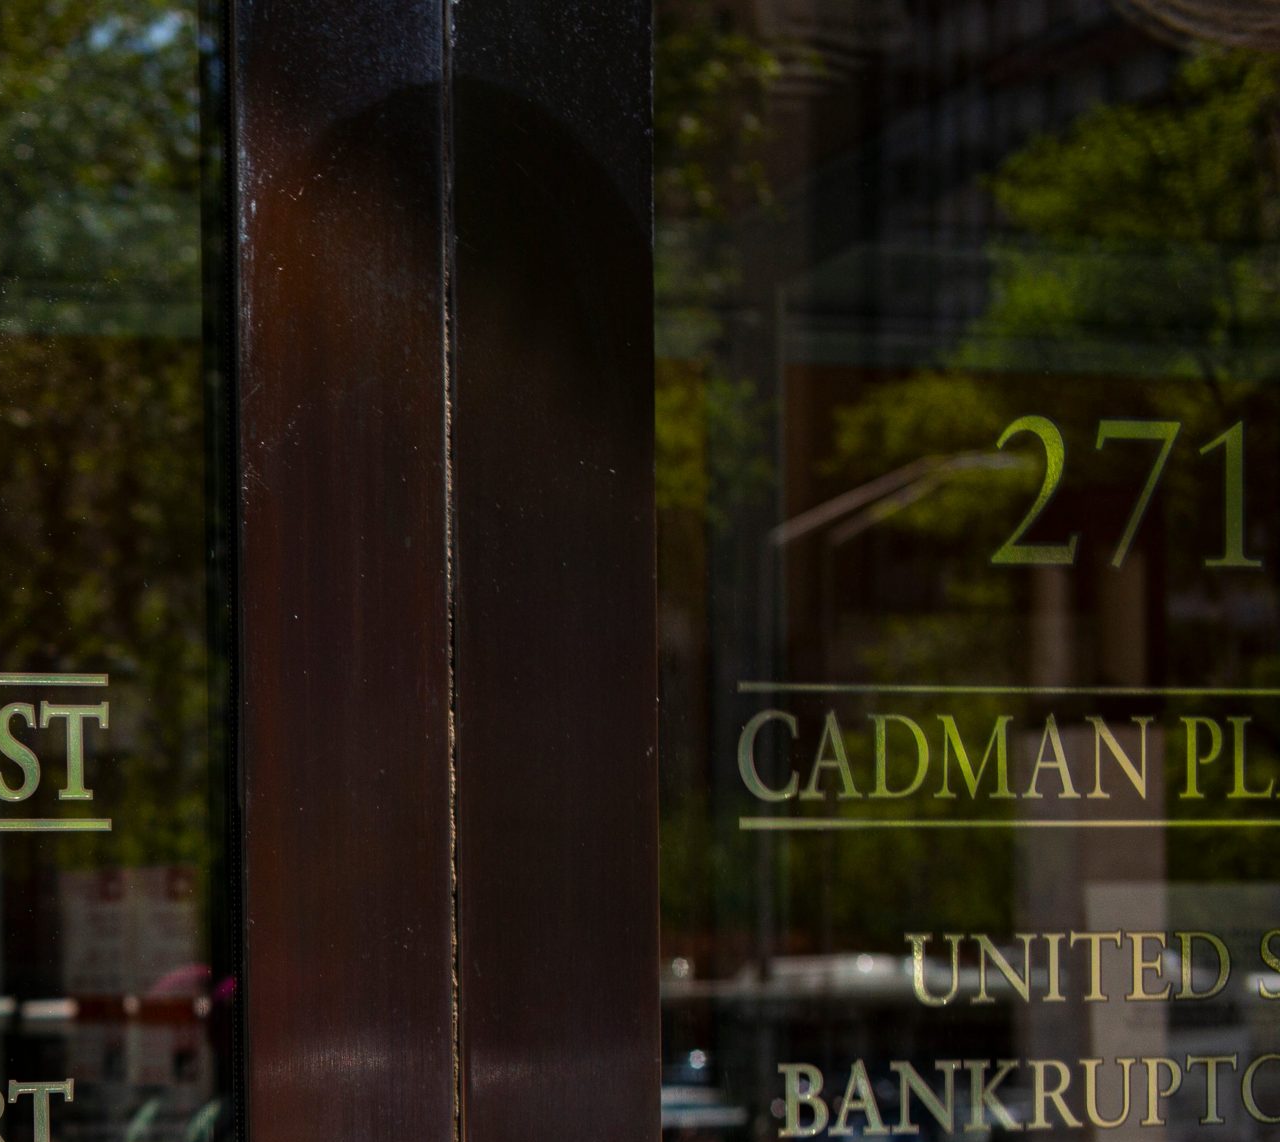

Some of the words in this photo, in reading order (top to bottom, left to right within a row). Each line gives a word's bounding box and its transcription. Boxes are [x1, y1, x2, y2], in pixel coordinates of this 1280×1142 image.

[991, 415, 1263, 568] 271
[737, 709, 1156, 802] CADMAN
[1179, 716, 1280, 798] PL
[904, 930, 1231, 1007] UNITED
[777, 1053, 1280, 1139] BANKRUPTC
